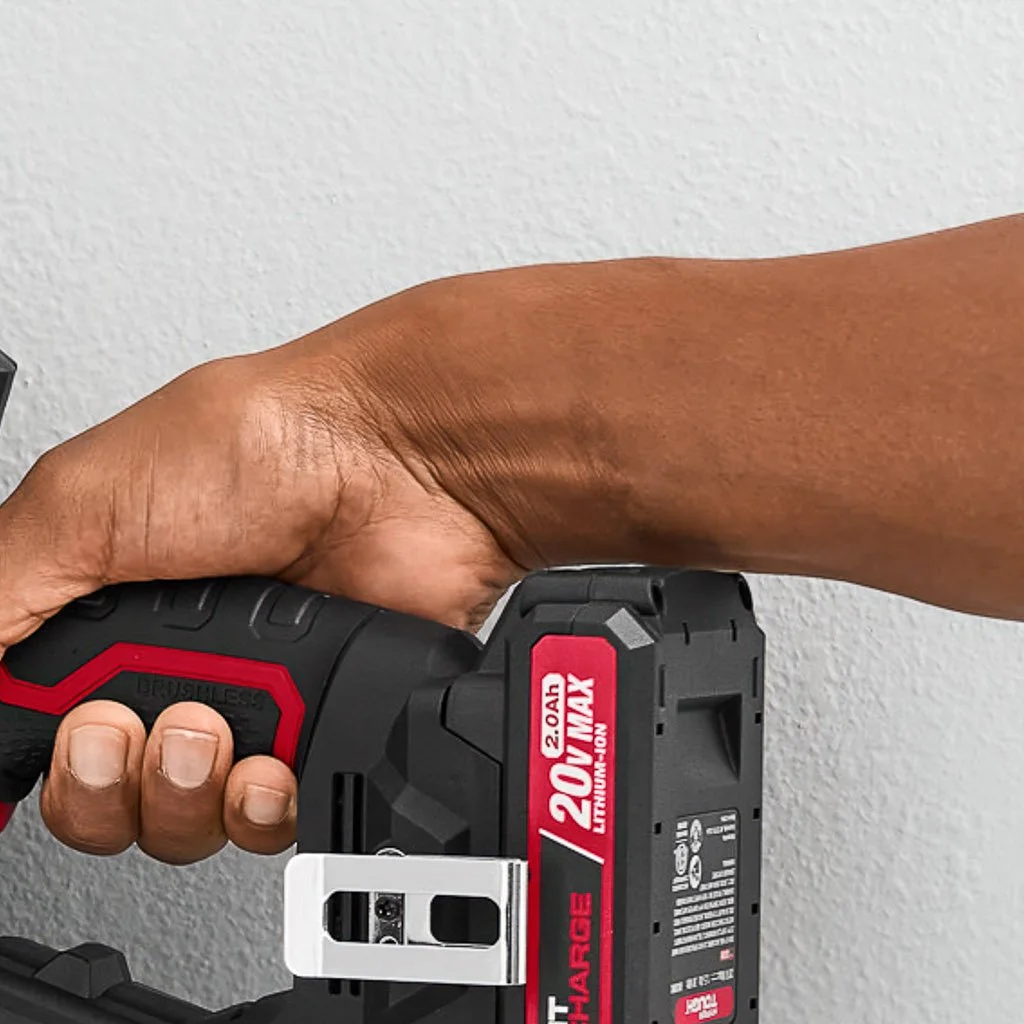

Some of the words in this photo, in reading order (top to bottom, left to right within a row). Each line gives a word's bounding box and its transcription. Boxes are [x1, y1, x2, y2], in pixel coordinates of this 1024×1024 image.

[545, 683, 560, 750] 2.0Ah
[566, 673, 594, 743] MAX
[593, 723, 608, 834] LITHIUM-ION
